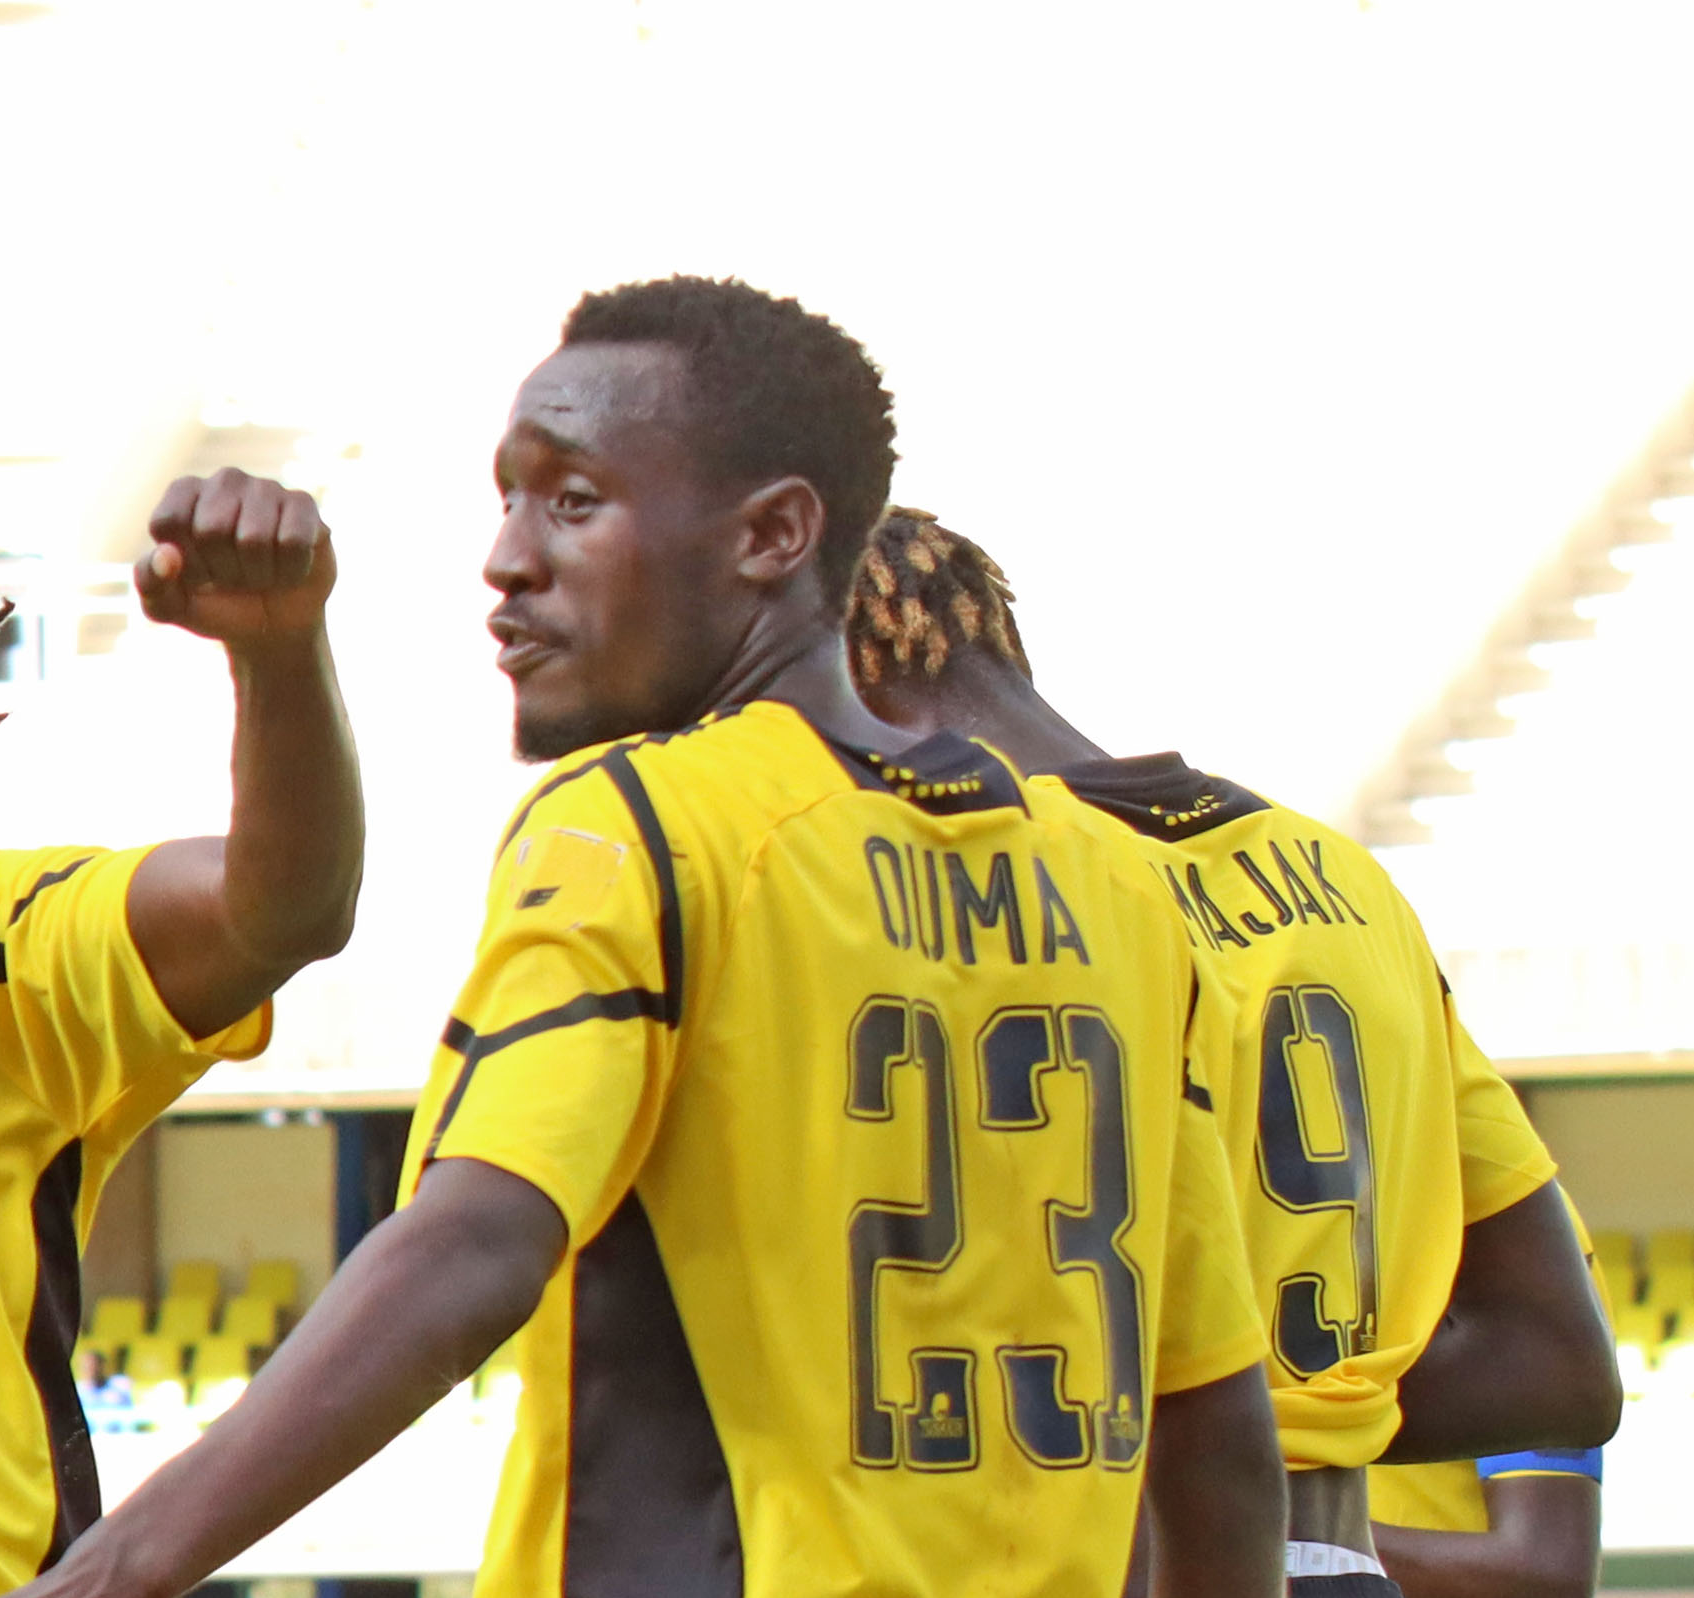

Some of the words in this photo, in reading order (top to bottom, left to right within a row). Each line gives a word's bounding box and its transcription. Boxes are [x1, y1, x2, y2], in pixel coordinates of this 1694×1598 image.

[864, 836, 1092, 966] OUMA
[845, 993, 1153, 1473] 23
[1255, 984, 1380, 1381] 9
